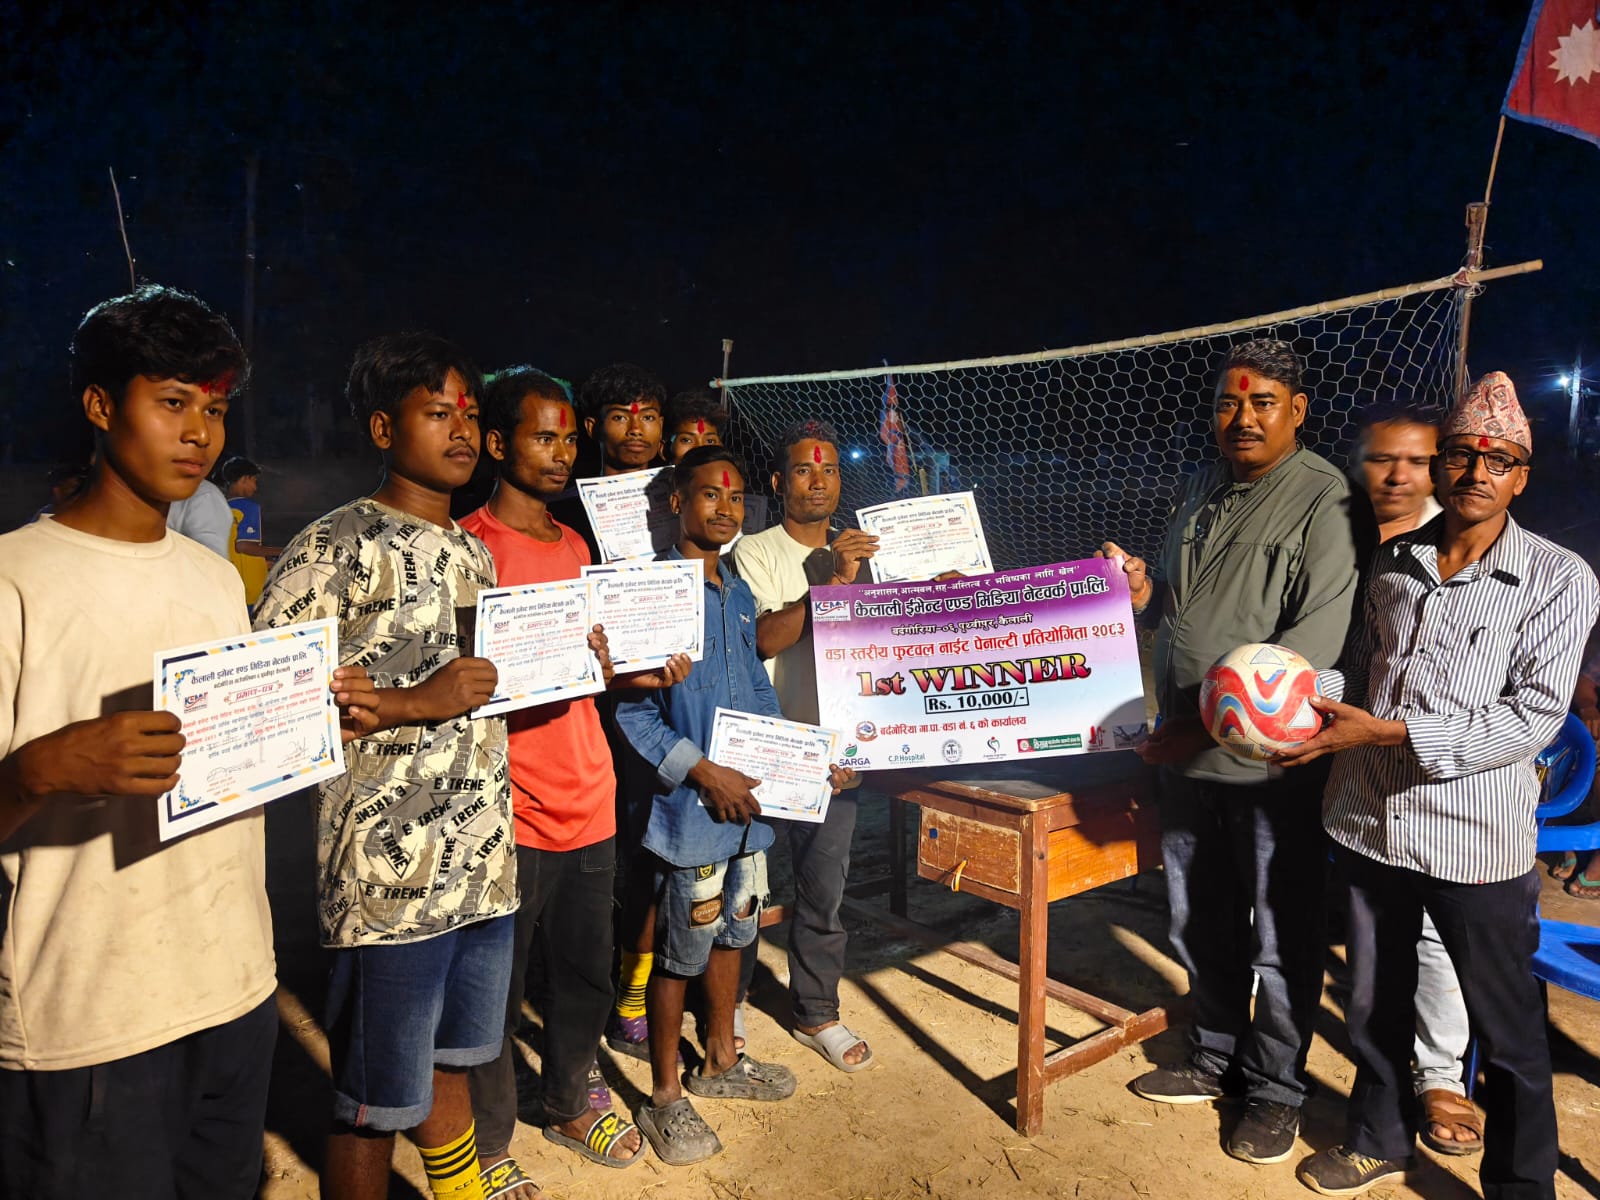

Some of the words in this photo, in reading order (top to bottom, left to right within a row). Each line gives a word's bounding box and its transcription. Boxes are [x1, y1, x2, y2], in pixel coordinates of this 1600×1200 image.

[402, 550, 418, 603] EXTREME
[984, 579, 991, 587] र
[995, 573, 1031, 585] भविष्यका
[1034, 569, 1054, 579] लागि
[855, 600, 902, 617] कैलाली
[945, 596, 971, 610] एण्ड
[976, 588, 1020, 608] मिडिया
[1023, 580, 1066, 601] नेटवर्क
[998, 613, 1033, 625] कैलाली
[825, 648, 846, 661] वडा
[850, 643, 888, 660] स्तरीय
[939, 636, 970, 655] नाईट
[973, 631, 1018, 651] पेनाल्टी
[1022, 624, 1088, 648] प्रतियोगिता
[1091, 622, 1125, 637] २०८३
[856, 671, 907, 697] 1st
[908, 652, 1091, 694] WINNER
[928, 697, 952, 711] Rs.
[957, 690, 1024, 710] 10,000/-
[942, 722, 957, 731] वडा
[969, 721, 976, 730] ६
[977, 717, 989, 729] को
[991, 715, 1027, 727] कार्यालय
[359, 741, 416, 756] EXTREME
[839, 756, 871, 767] SARGA
[900, 752, 926, 763] Hospital
[433, 777, 486, 791] EXTREME
[365, 884, 428, 900] EXTREME
